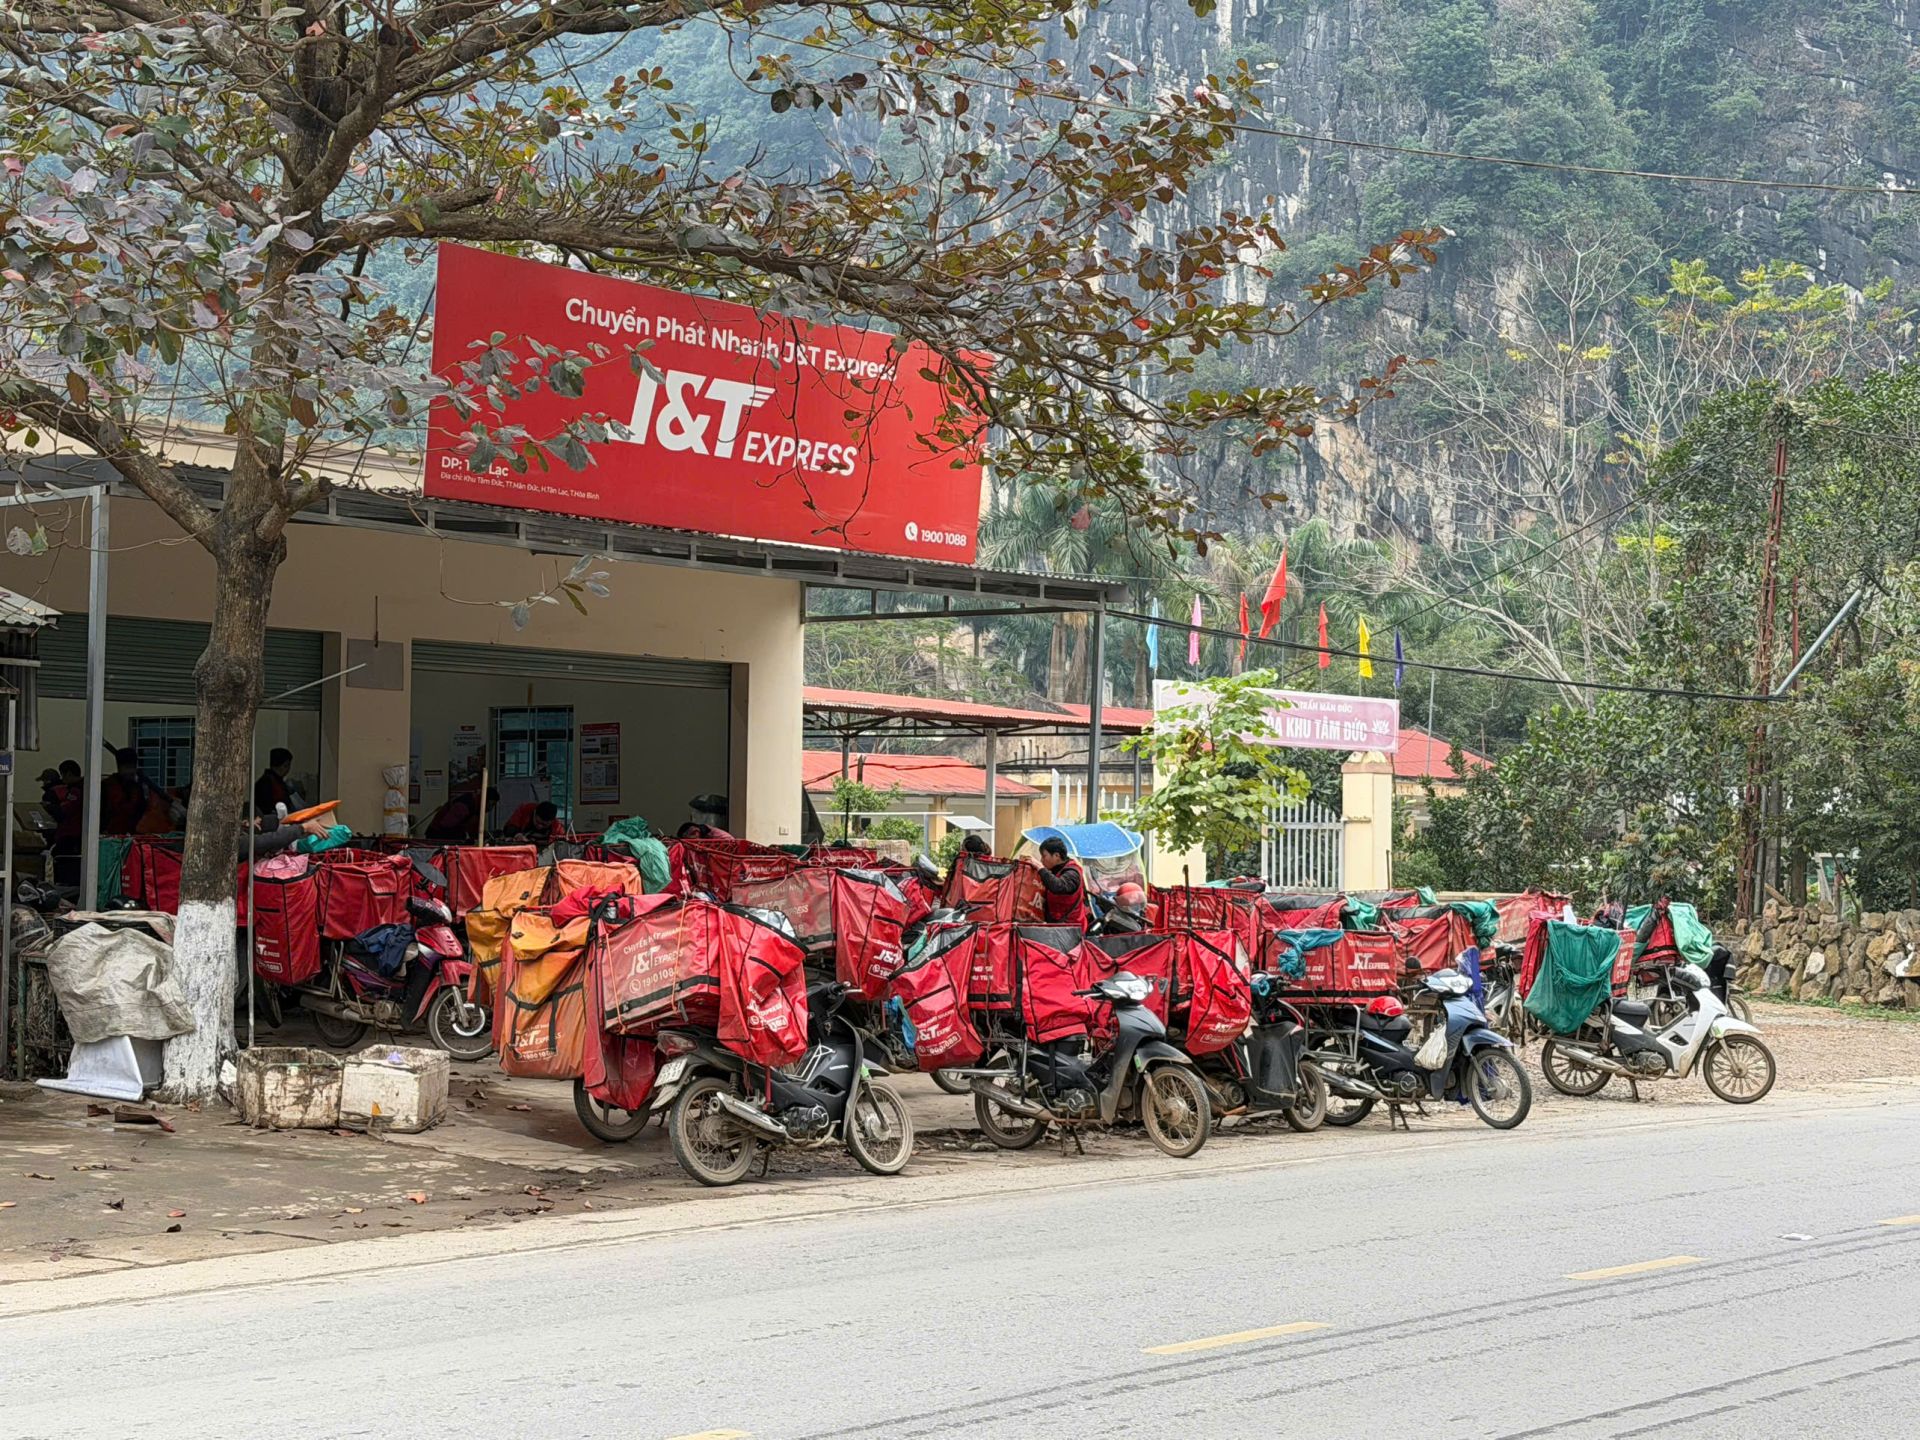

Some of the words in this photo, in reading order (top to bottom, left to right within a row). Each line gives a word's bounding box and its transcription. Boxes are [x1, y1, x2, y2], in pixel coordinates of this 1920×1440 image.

[565, 297, 650, 336] Chuyển
[656, 316, 706, 347] Phát
[711, 327, 779, 360] Nhanh
[824, 349, 898, 382] Express
[604, 366, 776, 459] J&T
[742, 432, 858, 477] EXPRESS
[488, 463, 510, 479] Lạc
[921, 529, 944, 544] 1900
[944, 532, 967, 547] 1088
[1286, 714, 1312, 739] KHU
[1315, 715, 1341, 740] TÂM
[1343, 717, 1368, 742] ĐỨC
